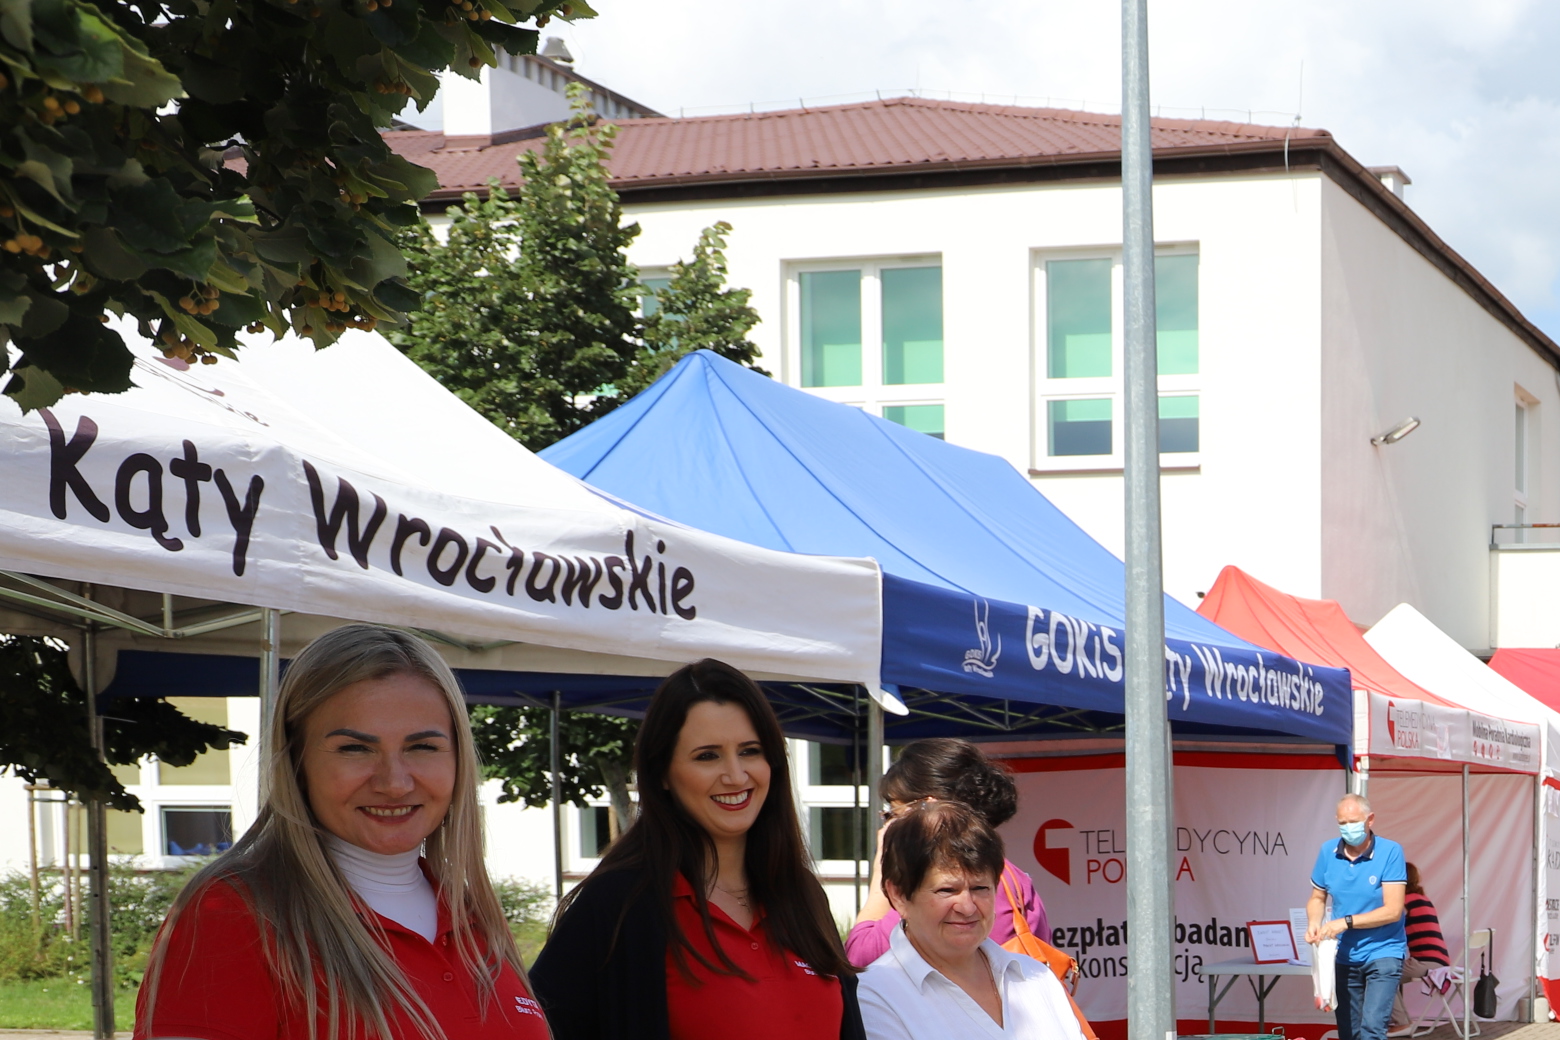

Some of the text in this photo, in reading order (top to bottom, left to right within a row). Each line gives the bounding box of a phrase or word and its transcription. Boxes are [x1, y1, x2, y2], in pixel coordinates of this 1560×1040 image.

[38, 406, 696, 620] Kąty Wrocławskie
[1190, 643, 1325, 717] Wrocławskie
[1079, 827, 1288, 856] TELDYCYNA
